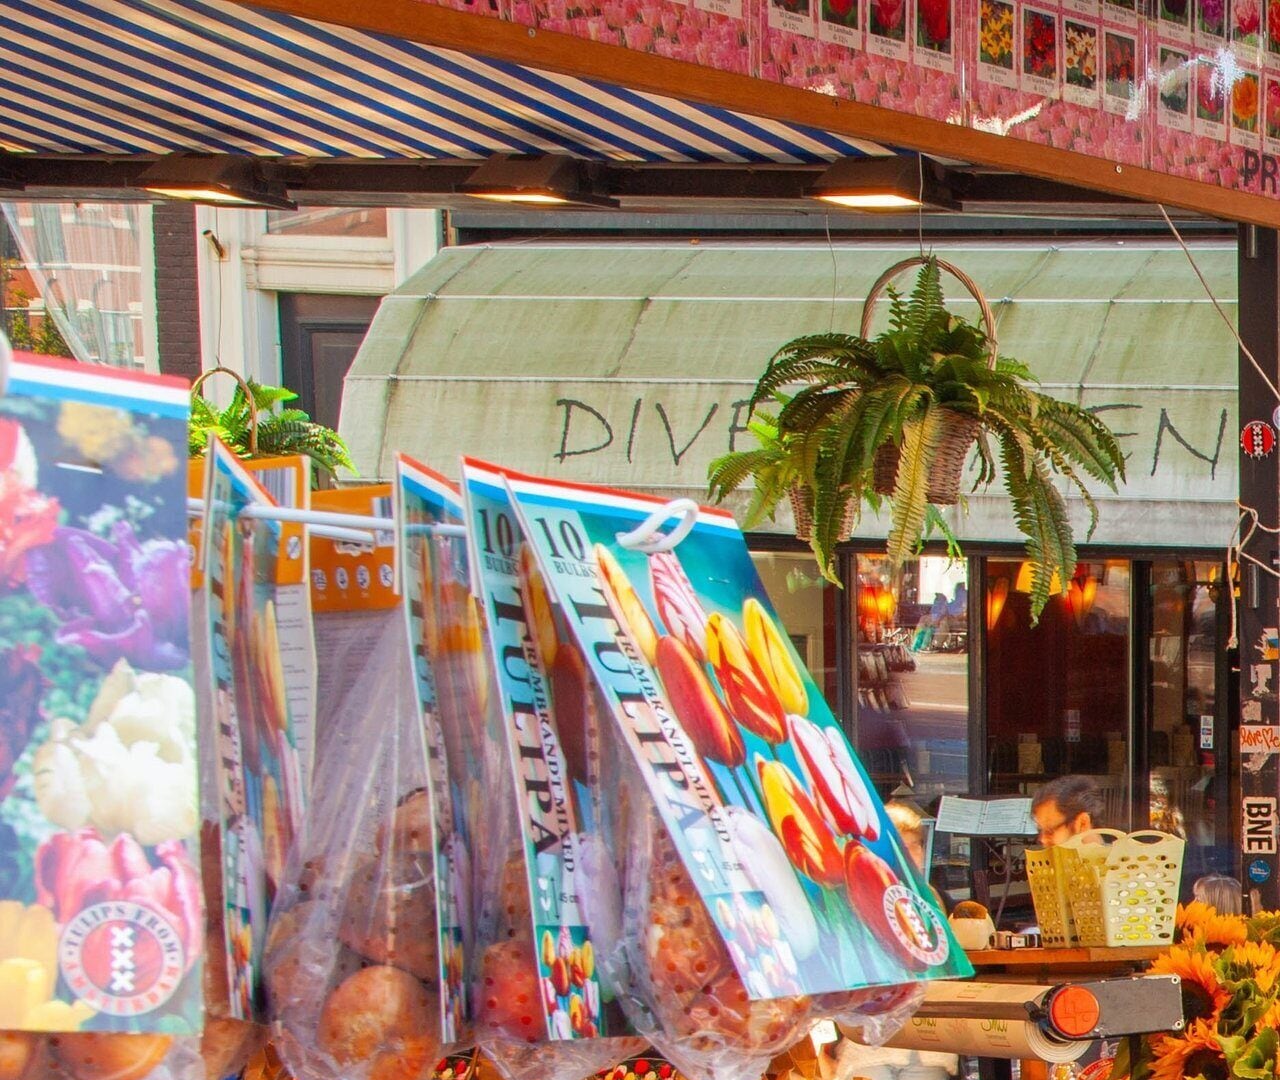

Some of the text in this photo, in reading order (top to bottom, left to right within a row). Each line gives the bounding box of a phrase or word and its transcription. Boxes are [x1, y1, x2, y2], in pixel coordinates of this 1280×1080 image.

[479, 508, 514, 556] 10
[535, 517, 587, 563] 10
[555, 561, 598, 579] BULBS
[492, 587, 559, 854] TULIPA
[571, 586, 707, 831] TULIPA
[526, 643, 576, 872] REMBRANDT MIXED
[622, 642, 731, 844] REMBRANDT MIXED
[1247, 803, 1274, 852] BNE
[67, 906, 177, 961] TULIPS FROM
